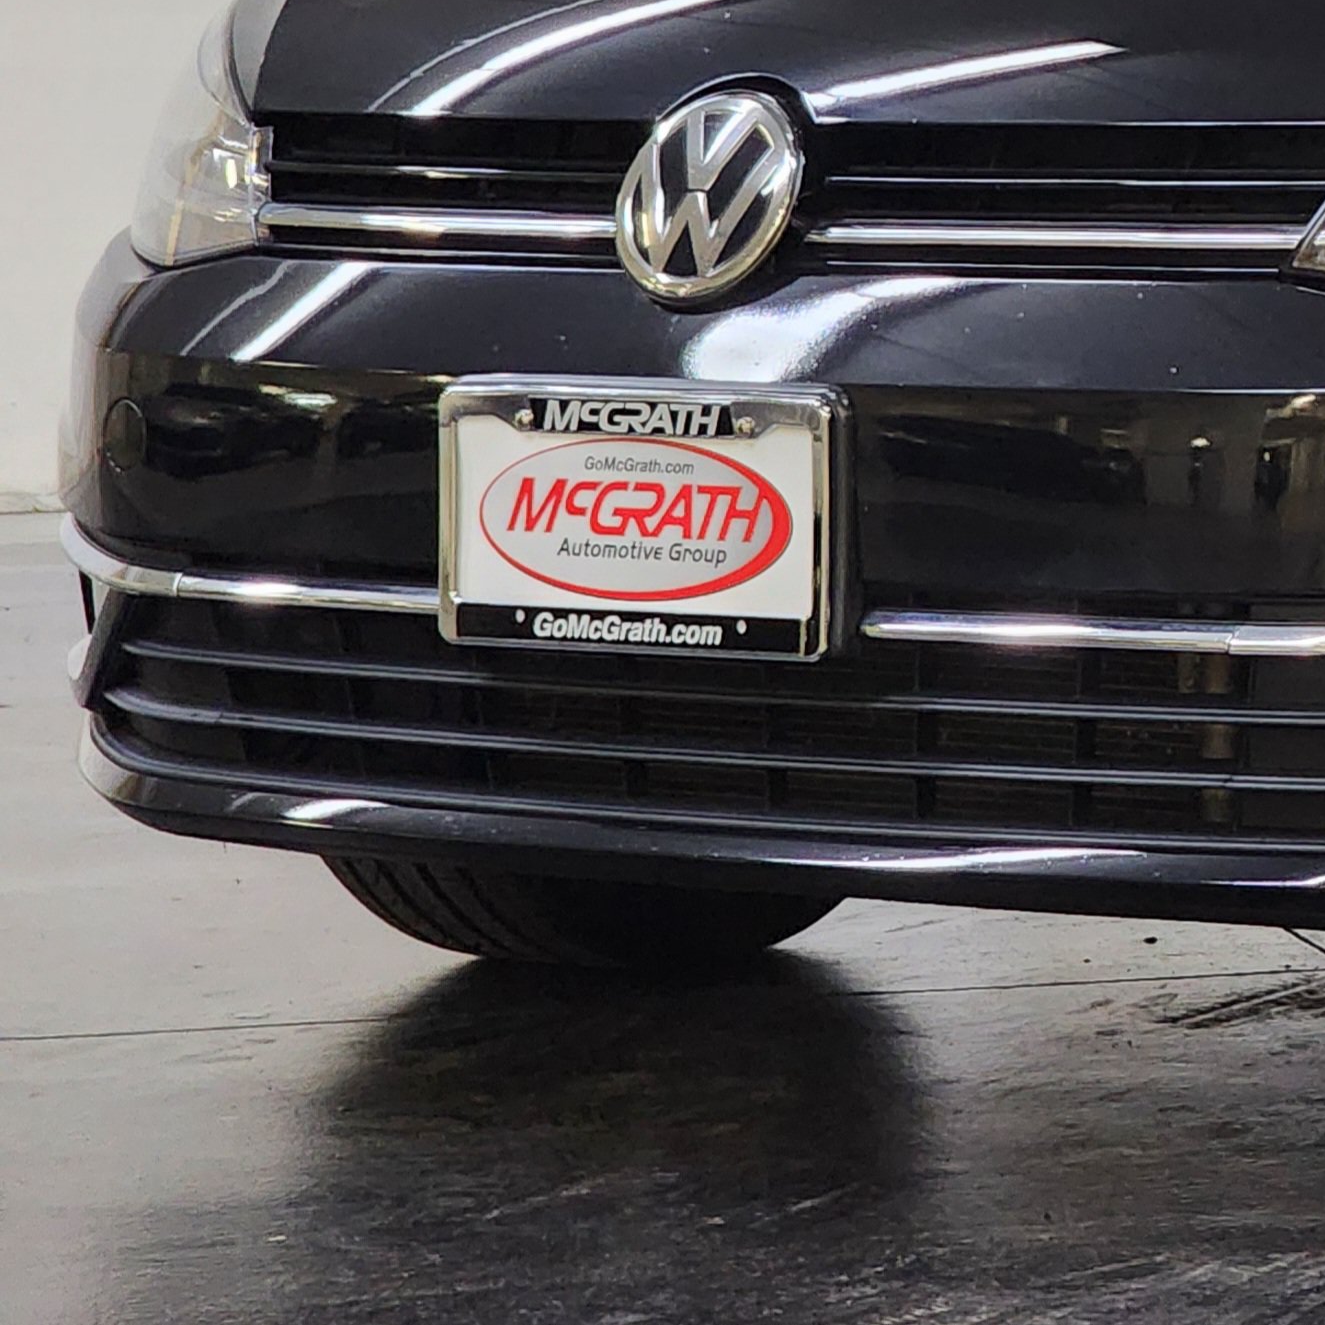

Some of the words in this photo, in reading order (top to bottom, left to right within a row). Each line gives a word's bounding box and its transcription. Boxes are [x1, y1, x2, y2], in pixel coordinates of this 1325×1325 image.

[583, 455, 695, 476] GoMcGrath.com
[557, 538, 663, 562] Automotive
[668, 543, 728, 566] Group
[532, 611, 723, 646] GoMcGrath.com
